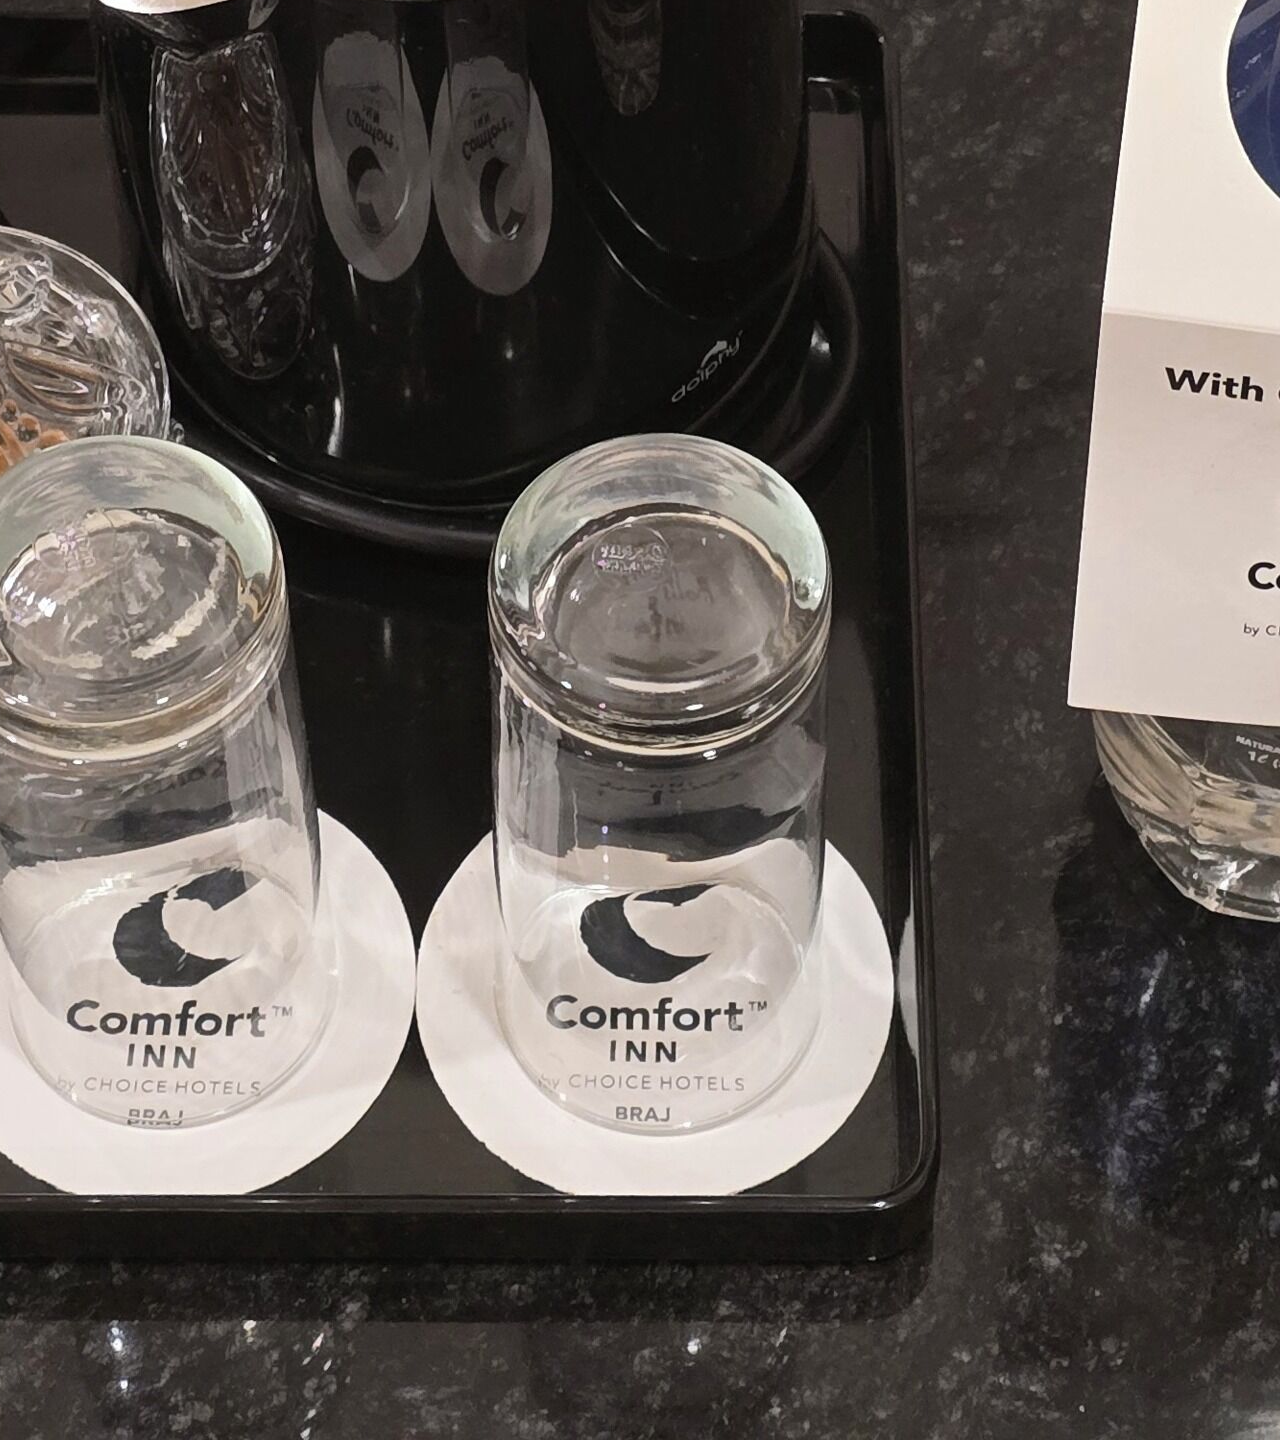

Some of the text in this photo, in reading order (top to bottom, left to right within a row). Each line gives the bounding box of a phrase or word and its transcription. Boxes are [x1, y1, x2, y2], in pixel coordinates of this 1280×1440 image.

[1164, 366, 1264, 403] With
[1243, 623, 1260, 638] by
[127, 1043, 197, 1069] INN
[609, 1039, 677, 1063] INN
[83, 1076, 167, 1094] CHOICE
[175, 1080, 262, 1097] HOTELS
[568, 1073, 651, 1090] CHOICE
[659, 1075, 745, 1092] HOTELS
[615, 1105, 671, 1123] BRAJ
